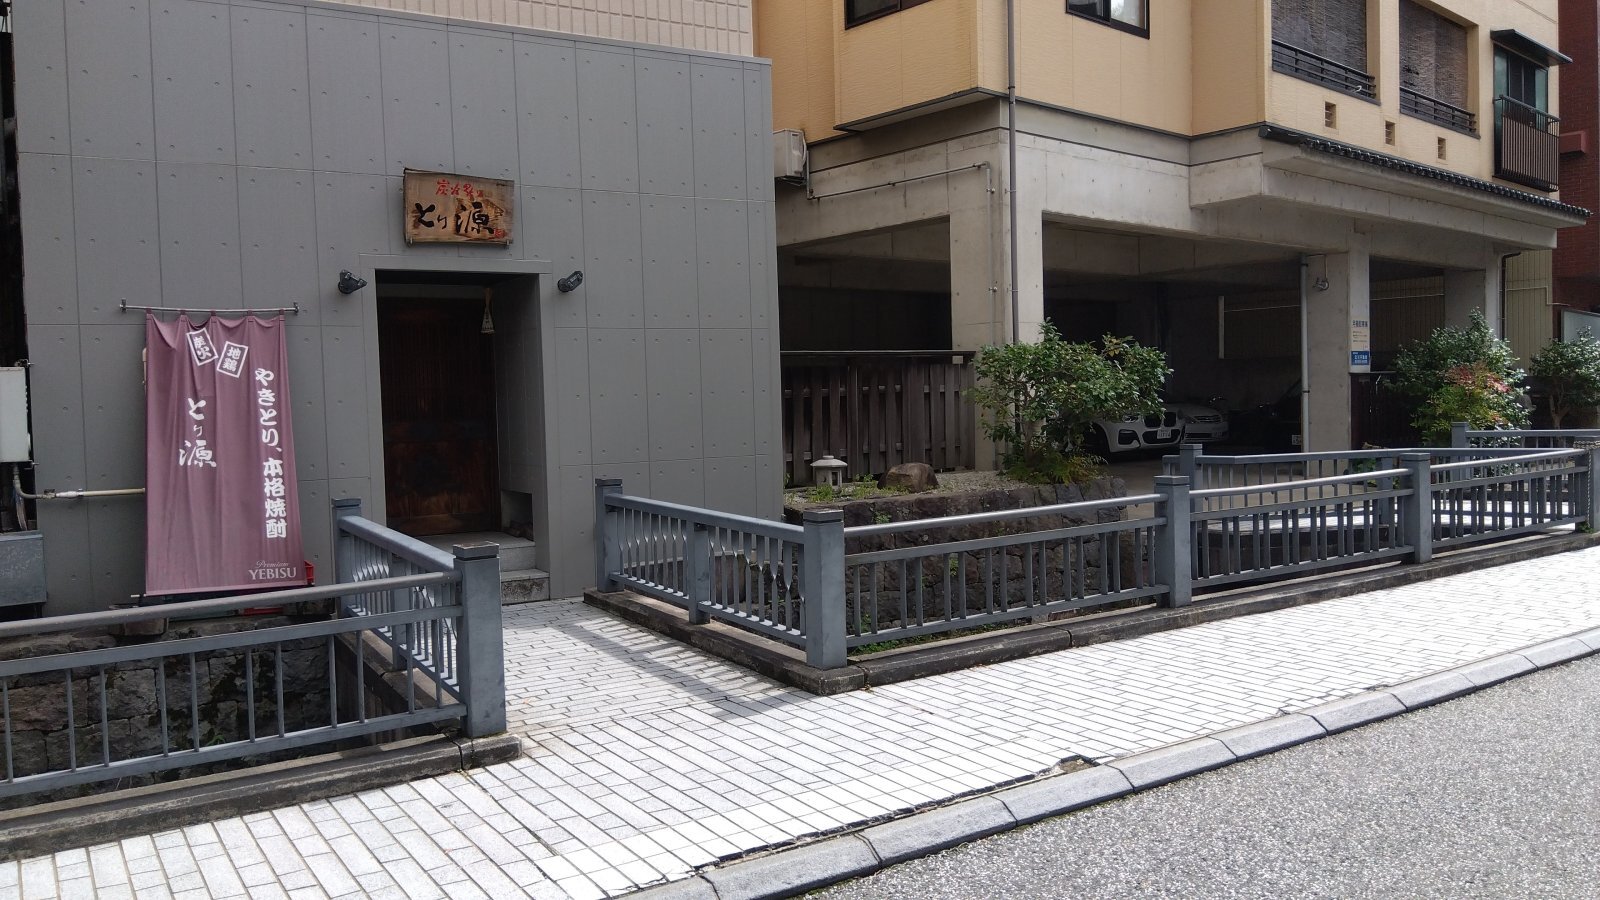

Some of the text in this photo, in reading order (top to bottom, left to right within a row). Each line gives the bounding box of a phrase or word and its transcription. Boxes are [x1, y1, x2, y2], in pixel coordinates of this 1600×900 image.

[415, 201, 494, 234] とり源
[179, 398, 216, 467] とり源
[248, 567, 297, 580] YEBISU
[256, 560, 289, 568] Premium
